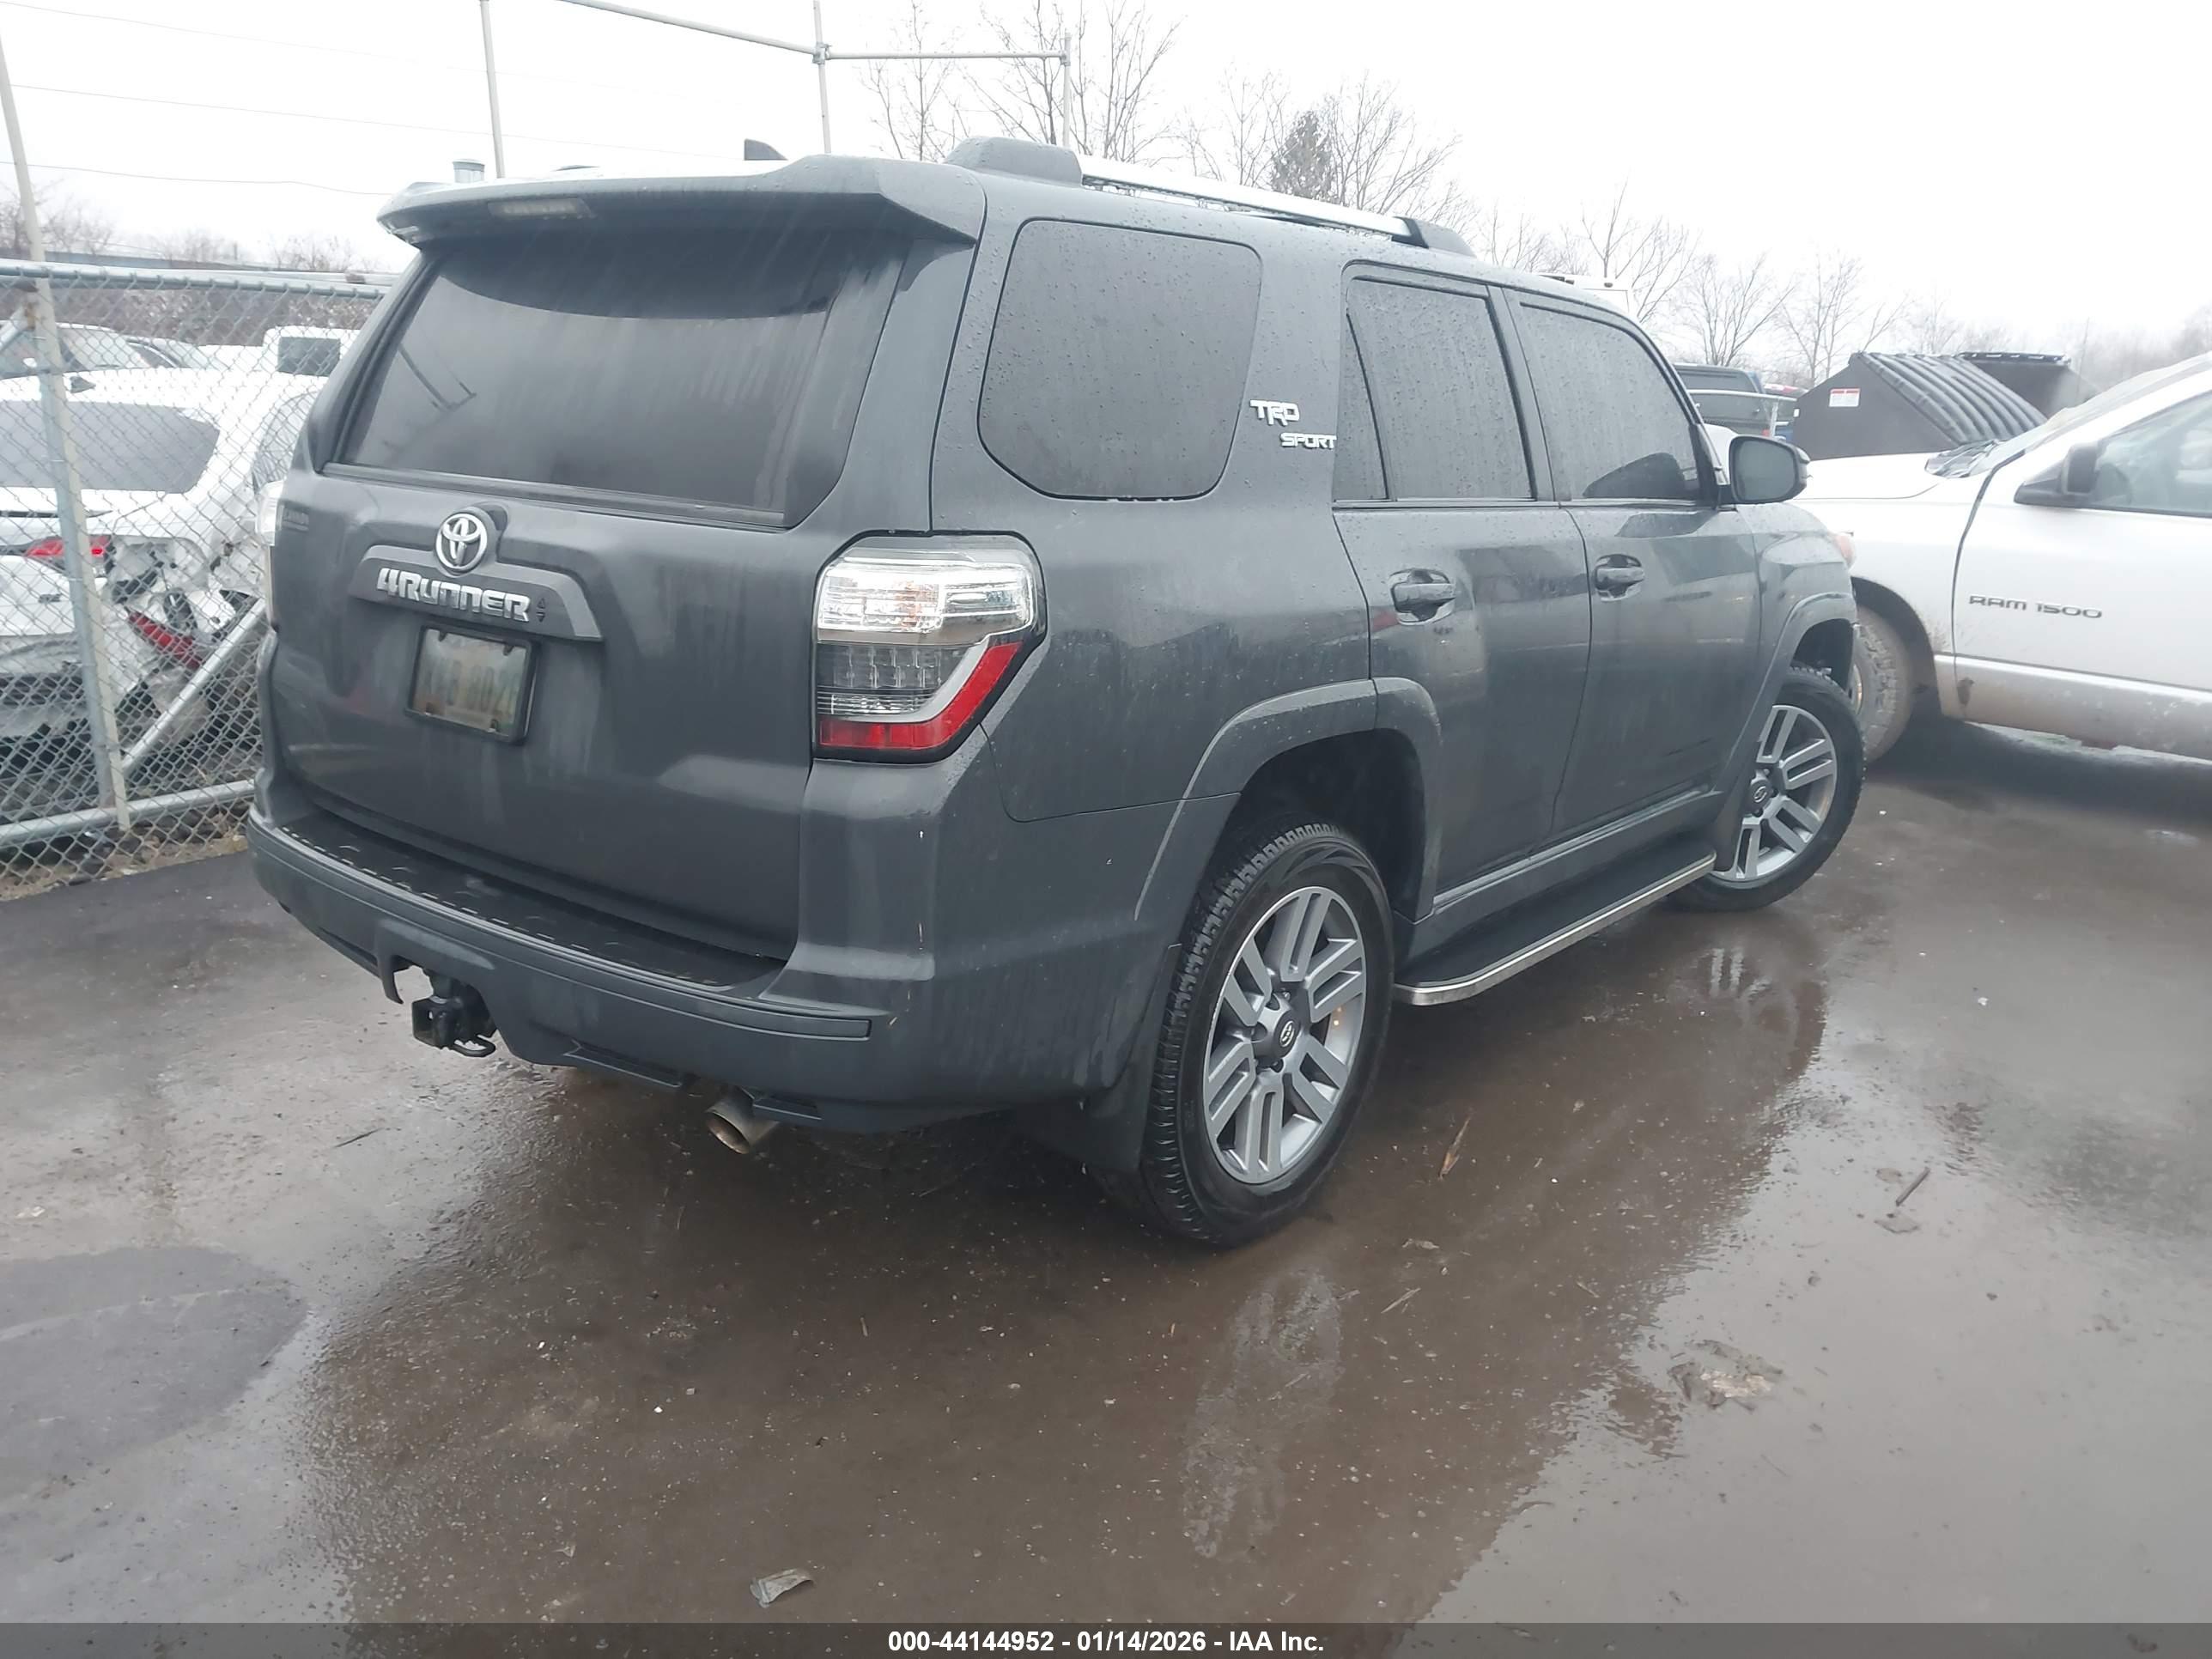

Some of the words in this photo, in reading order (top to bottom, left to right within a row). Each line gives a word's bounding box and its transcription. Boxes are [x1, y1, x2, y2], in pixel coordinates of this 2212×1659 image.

[1249, 399, 1300, 426] TRD
[1280, 432, 1337, 449] SPORT
[376, 568, 531, 623] 4RUNNER
[1968, 595, 2027, 611] RAM
[2036, 602, 2103, 619] 1500
